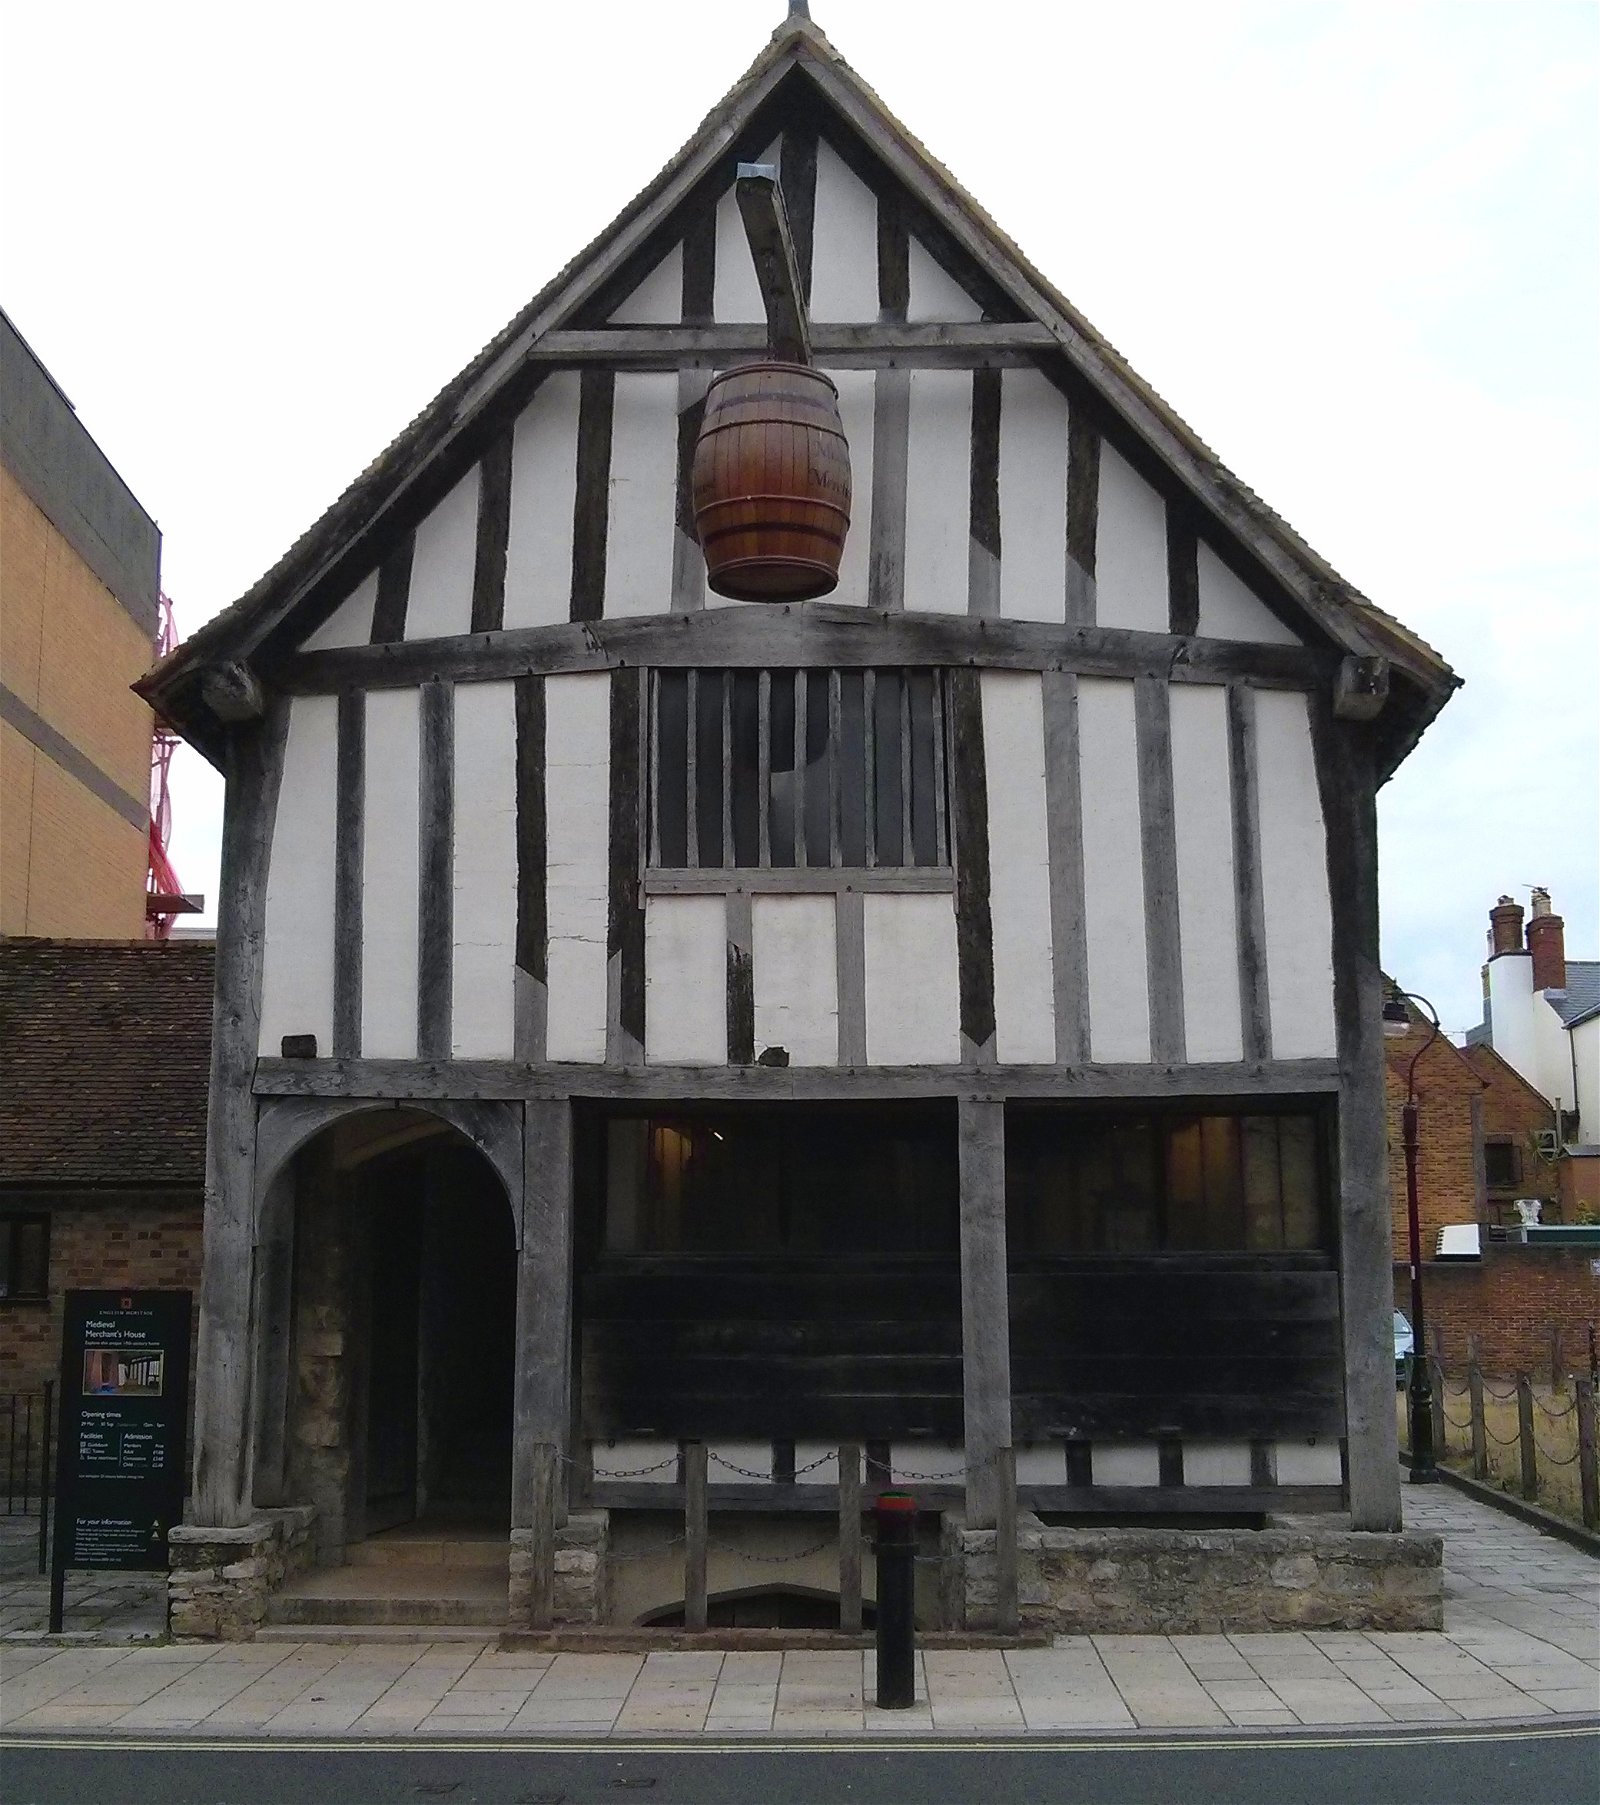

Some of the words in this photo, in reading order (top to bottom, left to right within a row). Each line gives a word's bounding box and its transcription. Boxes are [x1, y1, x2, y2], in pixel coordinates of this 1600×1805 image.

[85, 1320, 116, 1328] Medieval
[85, 1329, 122, 1338] Merchant's
[123, 1330, 146, 1338] House
[81, 1410, 105, 1419] Opening
[80, 1432, 104, 1440] Facilities
[76, 1517, 86, 1525] For
